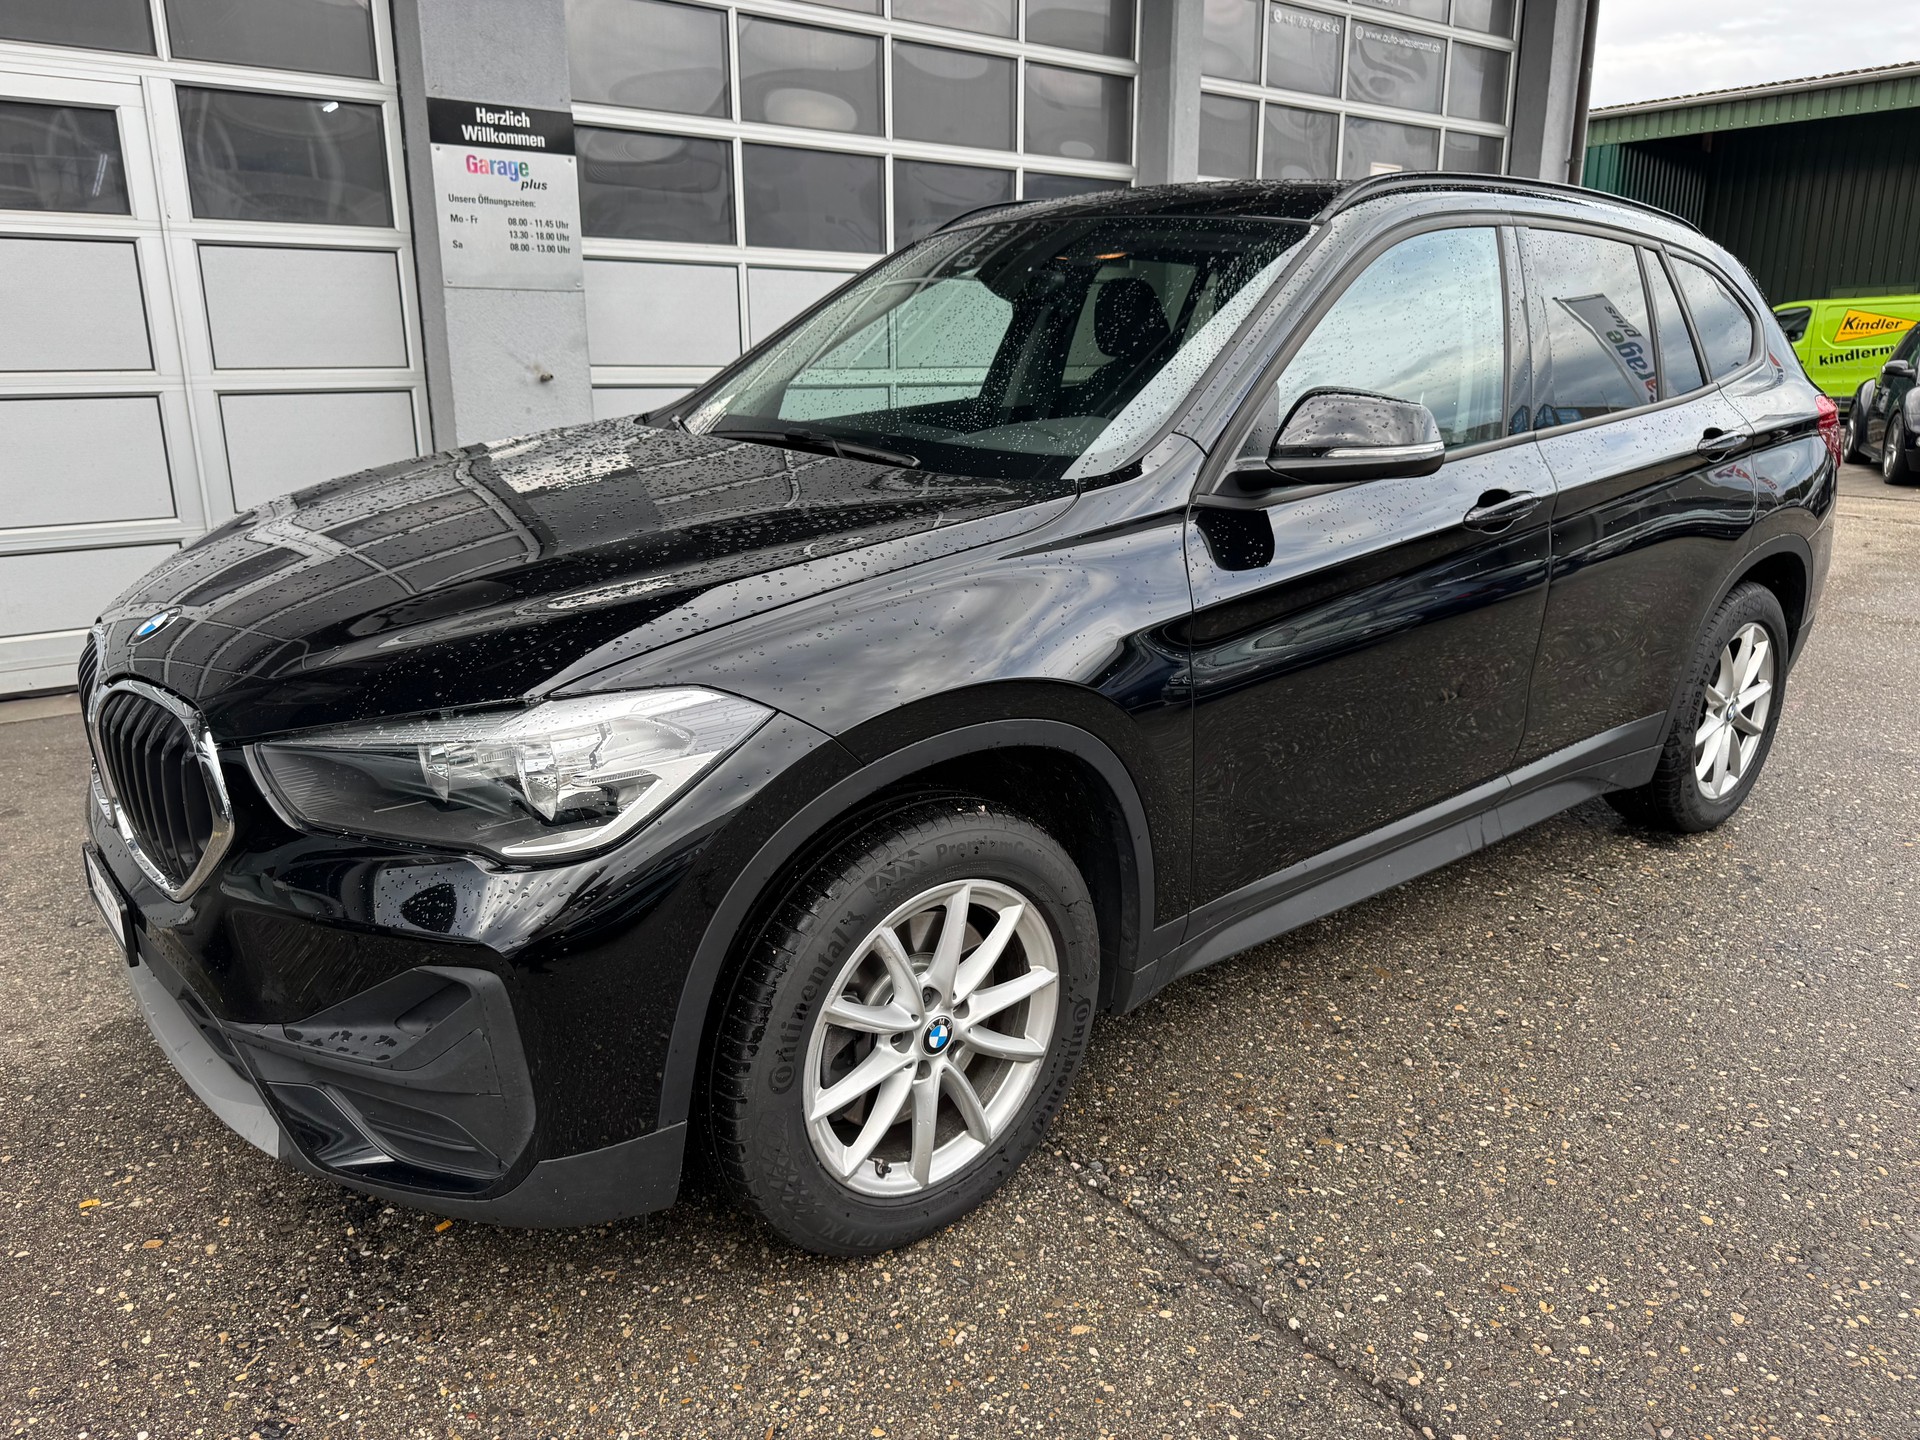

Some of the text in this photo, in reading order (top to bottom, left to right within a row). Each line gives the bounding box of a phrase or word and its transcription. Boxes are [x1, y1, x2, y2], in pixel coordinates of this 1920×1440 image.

[475, 106, 531, 128] Herzlich
[461, 124, 546, 148] Willkommen
[465, 154, 530, 182] Garage
[520, 178, 548, 191] plus
[448, 193, 536, 208] Unsere Öffnungszeiten:
[450, 213, 464, 223] Mo
[470, 214, 478, 224] Fr
[507, 217, 528, 227] 08.00
[535, 219, 554, 228] 11.45
[555, 220, 569, 229] Uhr
[509, 230, 529, 240] 13.30
[536, 232, 555, 241] 18.00
[556, 233, 570, 242] Uhr
[452, 239, 463, 249] Sa
[510, 243, 530, 252] 08.00
[537, 244, 556, 253] 13.00
[557, 245, 571, 254] Uhr
[1604, 305, 1642, 338] plus
[1843, 316, 1903, 330] Kindler
[1605, 330, 1656, 402] arage
